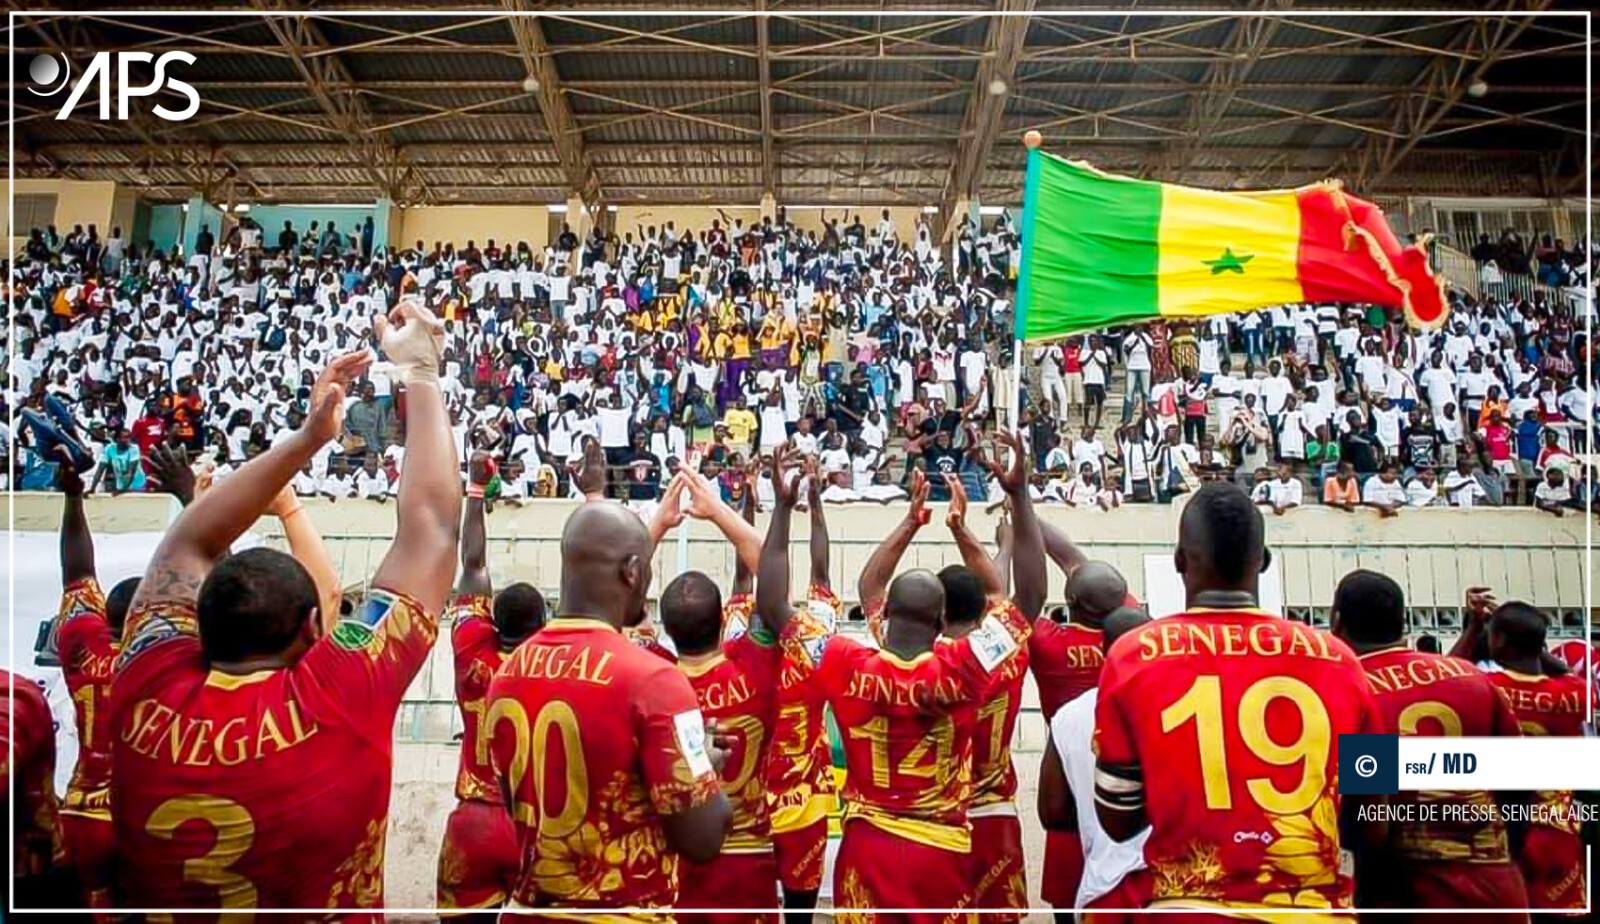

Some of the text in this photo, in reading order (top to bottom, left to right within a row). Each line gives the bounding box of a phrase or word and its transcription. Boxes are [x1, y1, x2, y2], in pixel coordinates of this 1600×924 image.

[1137, 622, 1342, 662] SENEGAL
[120, 699, 319, 766] SENEGAL
[484, 697, 589, 839] 20
[848, 716, 954, 789] 14
[1160, 675, 1331, 815] 19
[145, 793, 258, 924] 3
